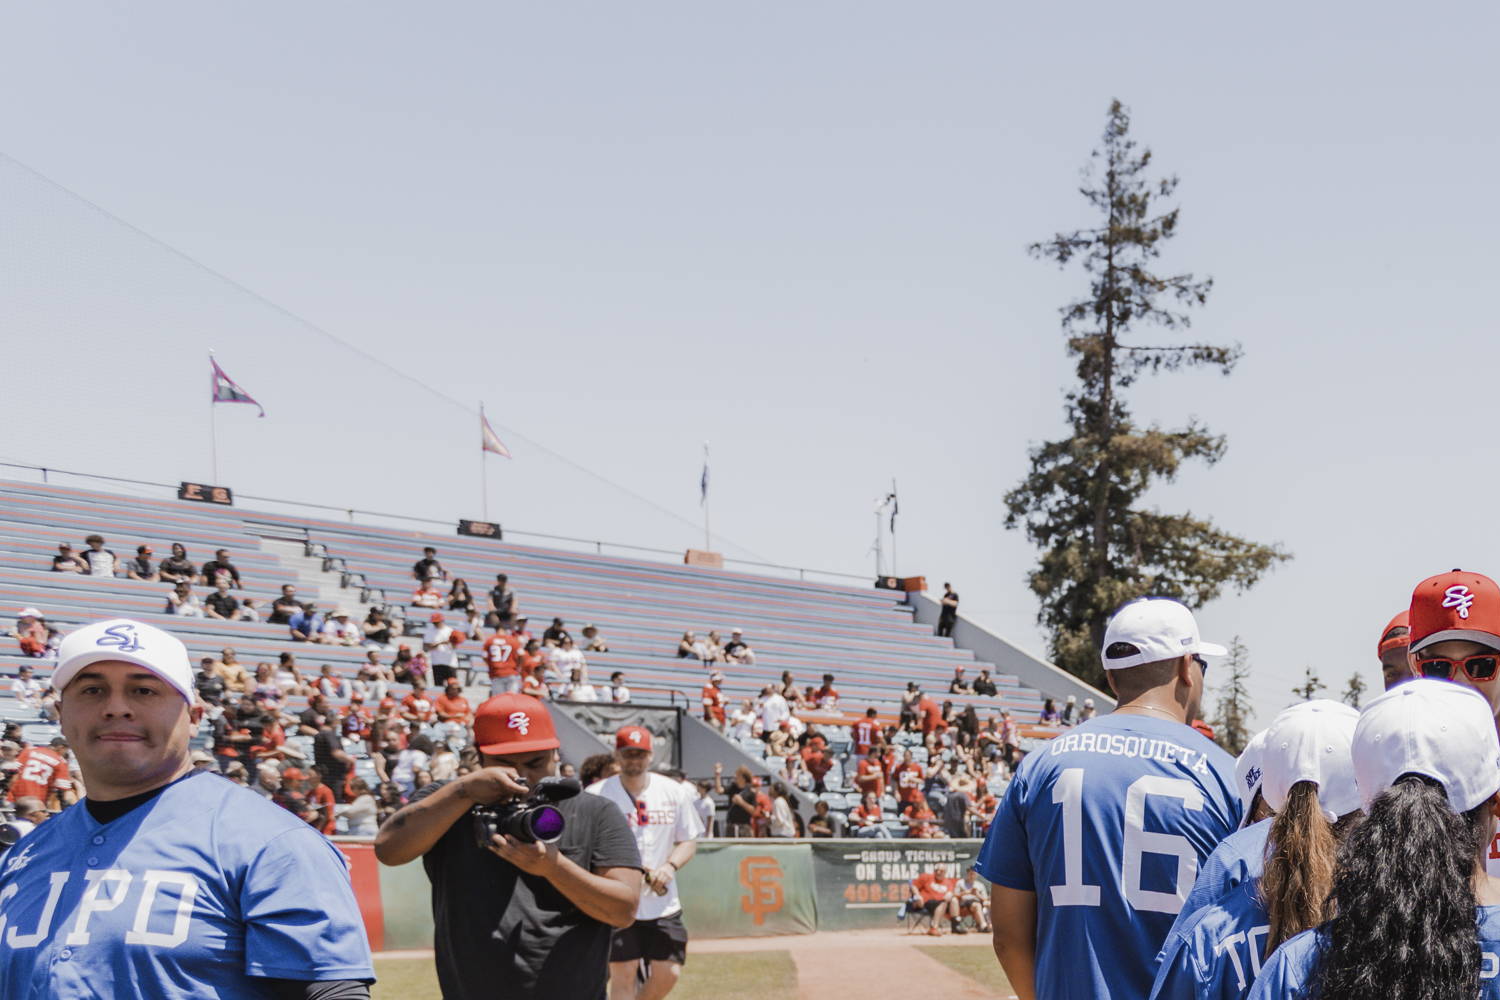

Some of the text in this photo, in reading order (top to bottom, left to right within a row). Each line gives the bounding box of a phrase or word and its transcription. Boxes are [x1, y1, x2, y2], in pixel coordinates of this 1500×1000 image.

[1050, 732, 1210, 775] ORROSQUIETA
[861, 850, 955, 862] GROUP TICKETS
[1049, 768, 1205, 916] 16
[856, 863, 876, 880] ON
[881, 863, 919, 880] SALE
